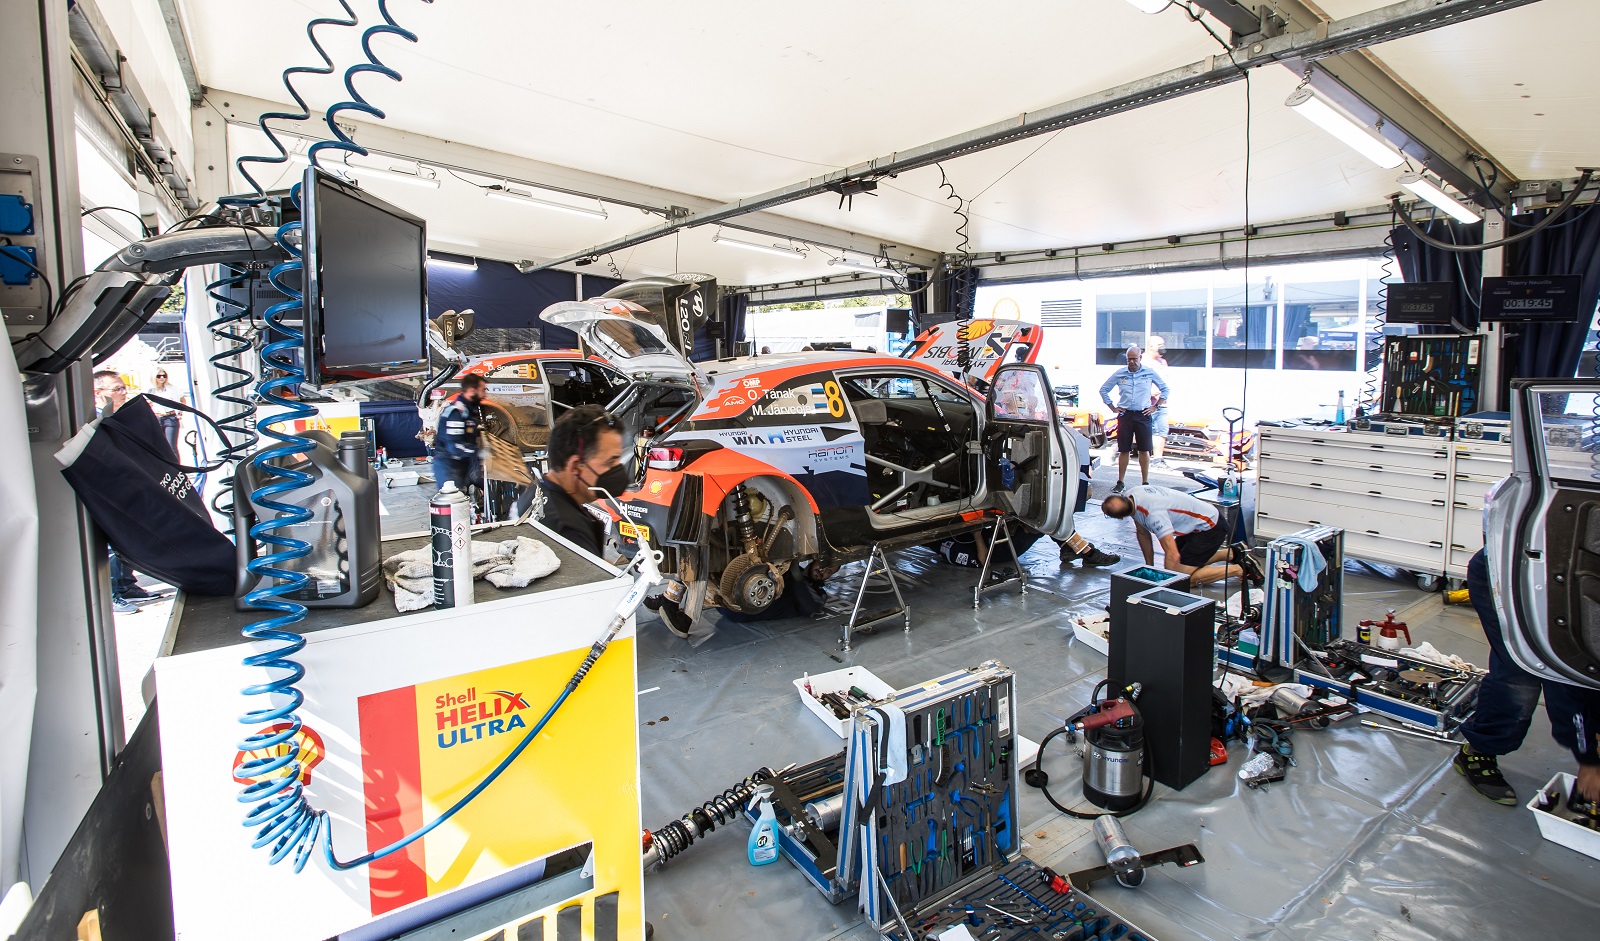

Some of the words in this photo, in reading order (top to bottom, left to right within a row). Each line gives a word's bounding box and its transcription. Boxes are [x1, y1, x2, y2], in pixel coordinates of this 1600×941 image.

[1504, 299, 1551, 308] 00:19:45
[528, 363, 538, 380] 6
[742, 378, 761, 388] OMP
[747, 389, 760, 400] O.
[762, 387, 796, 400] Tänak
[724, 399, 746, 407] AMG
[824, 381, 844, 418] 8
[751, 404, 767, 416] M.
[783, 427, 820, 435] HYUNDAI
[785, 434, 813, 443] STEEL
[628, 504, 648, 513] HYUNDAI
[435, 686, 477, 709] Shell
[435, 691, 528, 731] HELIX
[437, 713, 527, 749] ULTRA
[757, 836, 767, 847] Cif
